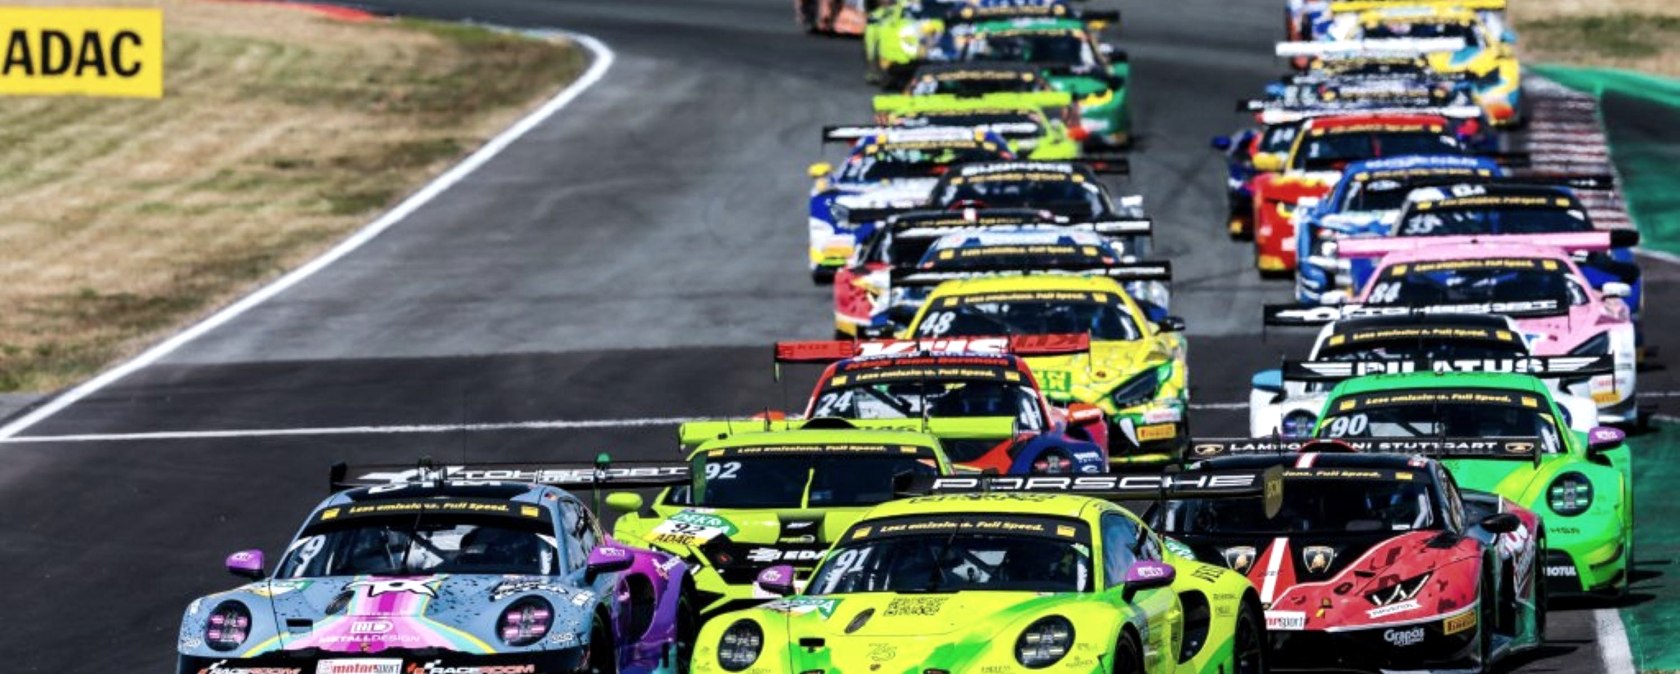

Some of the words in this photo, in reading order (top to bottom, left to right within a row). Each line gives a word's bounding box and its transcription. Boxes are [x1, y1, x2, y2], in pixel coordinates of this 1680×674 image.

[3, 29, 144, 78] ADAC
[919, 310, 956, 336] 48
[1356, 357, 1543, 377] PILATUS
[818, 390, 853, 413] 24
[1364, 397, 1389, 406] Less
[1474, 395, 1512, 404] Speed.
[1330, 414, 1367, 439] 90
[704, 462, 741, 480] 92
[931, 475, 1256, 491] PORSCHE
[349, 505, 375, 514] Less
[443, 501, 468, 510] Full
[469, 502, 509, 513] Speed.
[880, 524, 906, 534] Less
[975, 520, 1003, 529] Full
[1003, 521, 1045, 533] Speed.
[783, 549, 830, 561] EDA
[835, 549, 873, 573] 91
